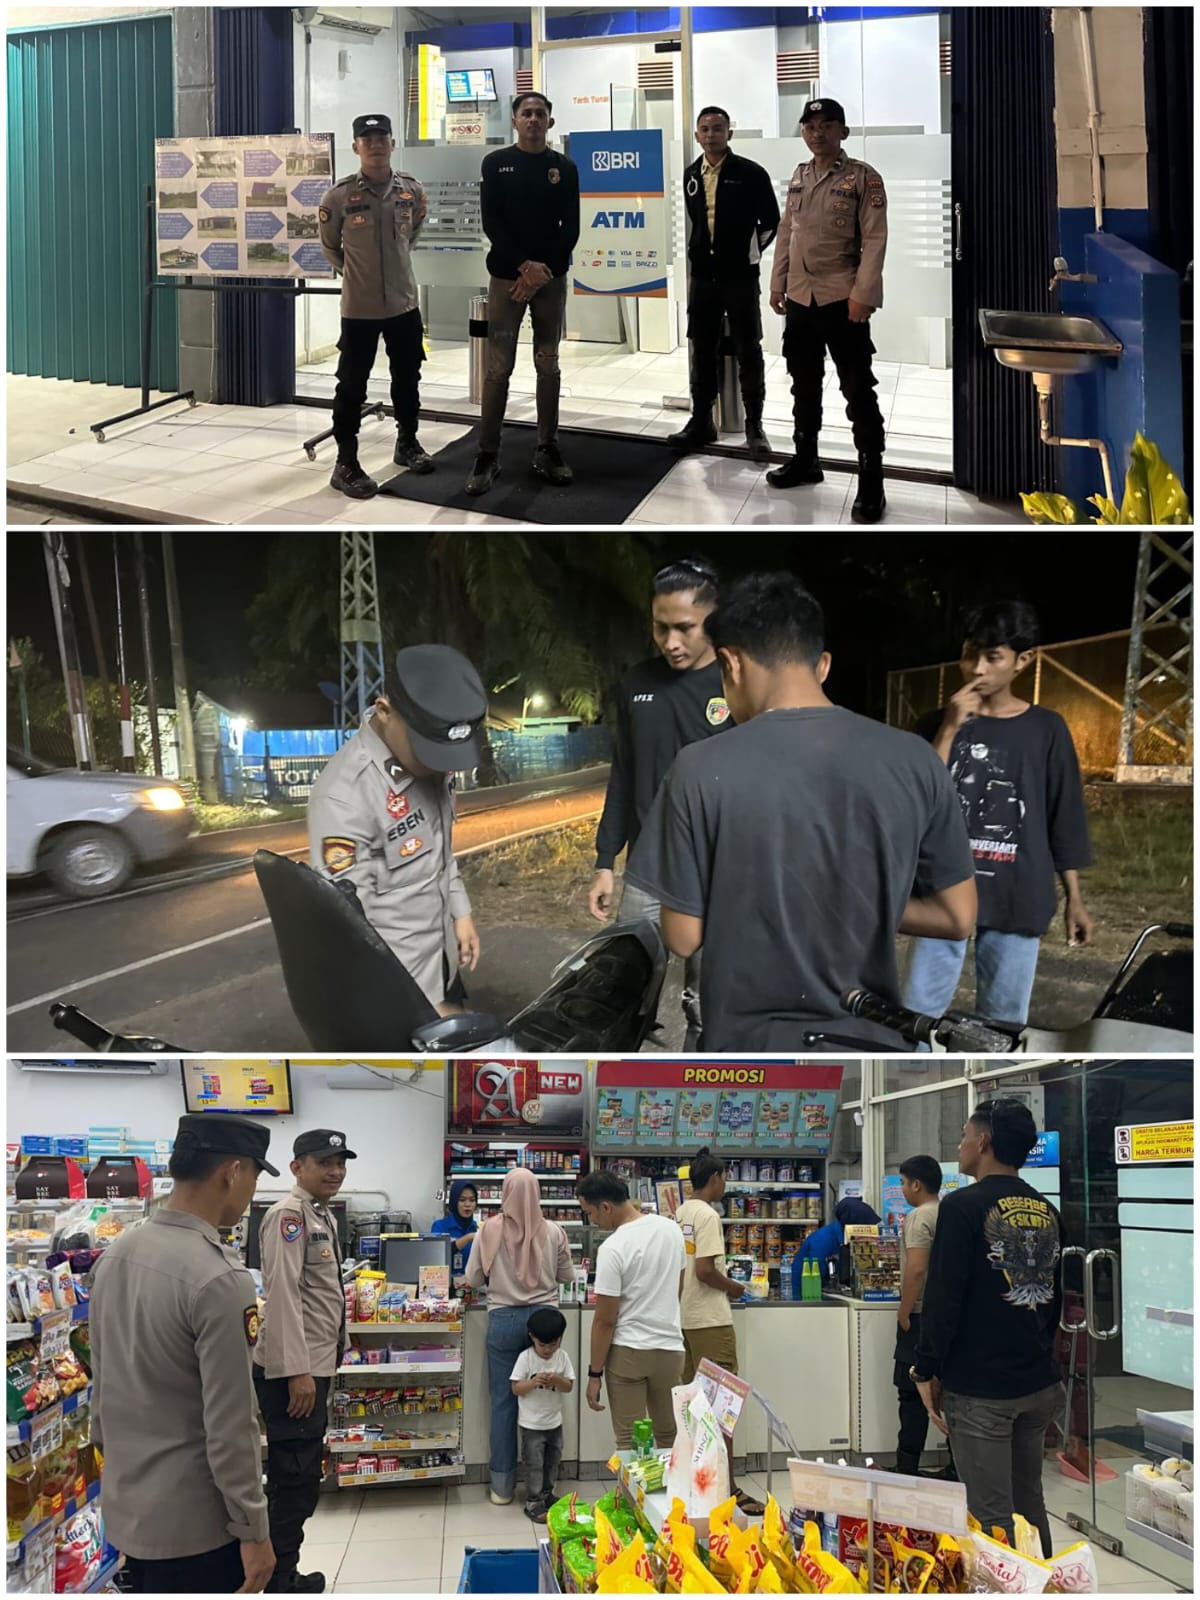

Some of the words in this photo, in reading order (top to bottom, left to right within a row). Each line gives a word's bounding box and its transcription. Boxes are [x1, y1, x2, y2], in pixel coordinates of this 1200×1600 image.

[610, 151, 640, 168] BRI
[591, 211, 645, 228] ATM
[387, 809, 425, 842] EBEN
[541, 1075, 580, 1089] NEW
[683, 1068, 765, 1084] PROMOSI
